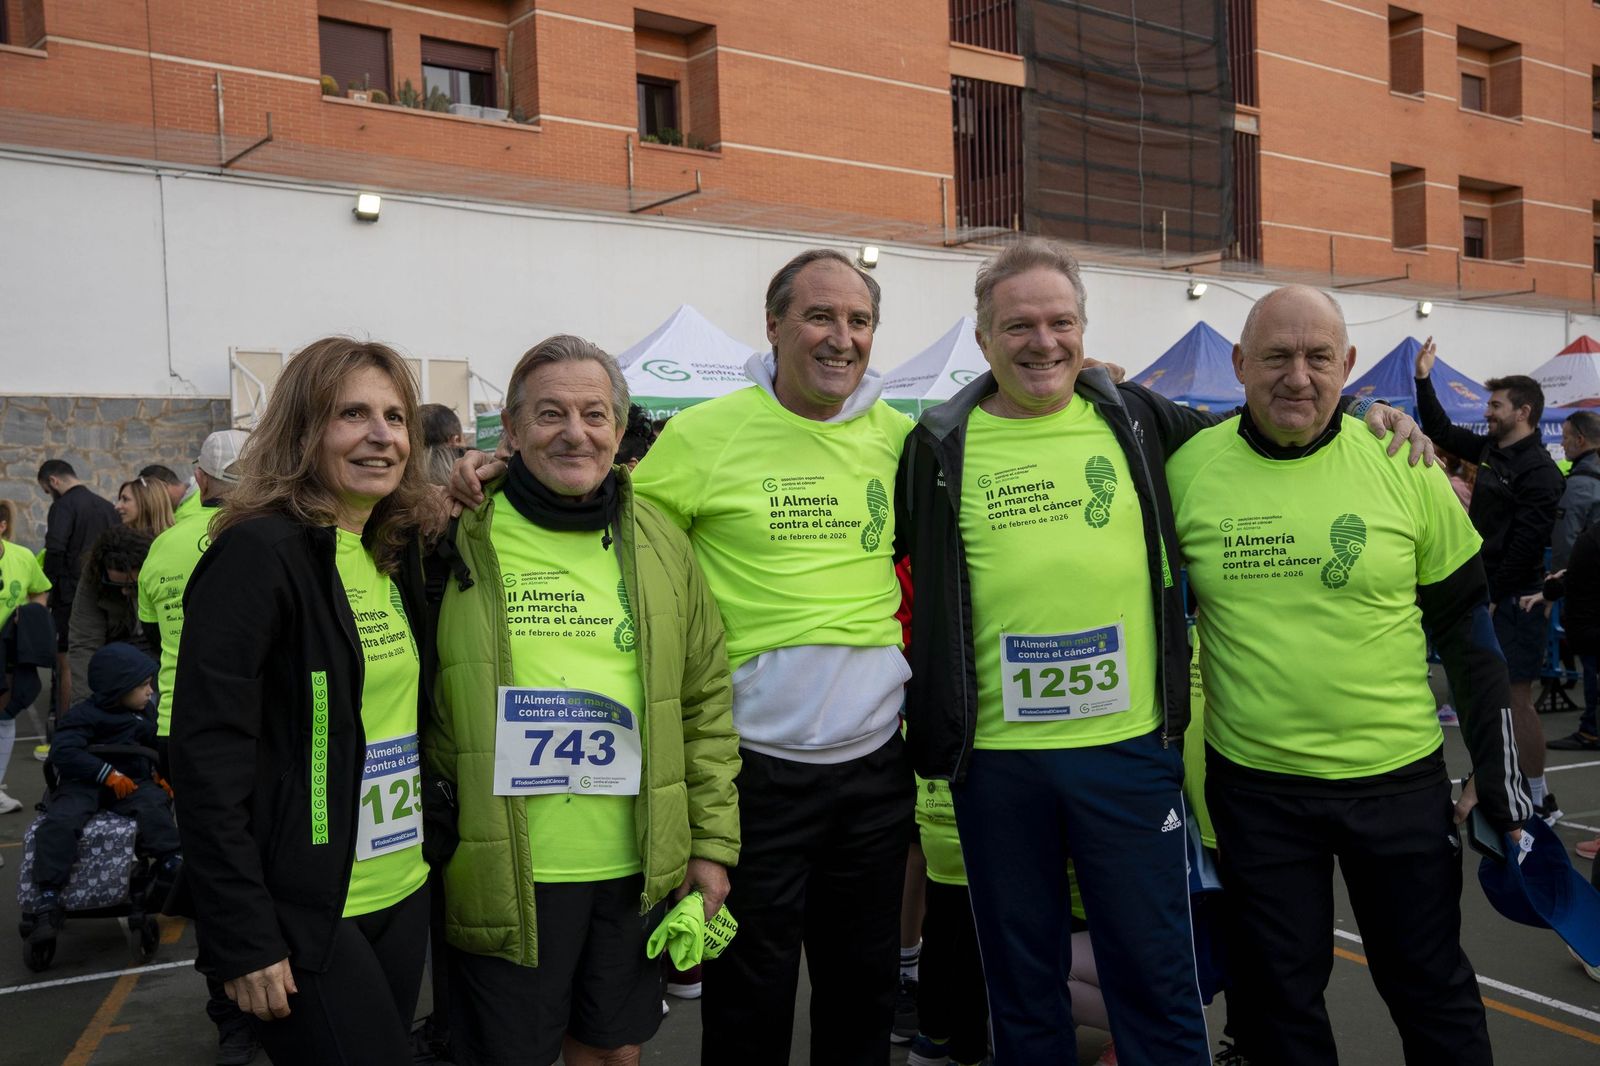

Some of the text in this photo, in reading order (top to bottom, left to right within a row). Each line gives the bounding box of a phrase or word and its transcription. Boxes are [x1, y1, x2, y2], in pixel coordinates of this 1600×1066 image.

[985, 479, 1056, 501] II Almería
[770, 494, 839, 507] II Almería
[987, 492, 1050, 511] en marcha
[770, 507, 833, 518] en marcha
[987, 498, 1083, 521] contra el cáncer
[769, 518, 862, 530] contra el cáncer
[997, 522, 1007, 530] de
[1009, 518, 1037, 529] febrero
[1038, 516, 1048, 524] de
[1049, 513, 1069, 522] 2026
[777, 533, 787, 541] de
[789, 532, 817, 541] febrero
[819, 532, 828, 540] de
[829, 532, 847, 540] 2026
[1223, 533, 1296, 548] II Almería
[1223, 546, 1287, 558] en marcha
[1222, 556, 1322, 569] contra el cáncer
[1240, 572, 1269, 581] febrero
[1283, 570, 1304, 578] 2026
[508, 590, 585, 602] II Almería
[507, 603, 578, 613] en marcha
[507, 614, 614, 625] contra el cáncer
[515, 629, 526, 637] de
[529, 629, 560, 638] febrero
[562, 630, 573, 638] de
[575, 630, 597, 638] 2026
[1018, 639, 1058, 649] Almería
[1075, 632, 1107, 645] marcha
[1018, 646, 1096, 659] contra el cáncer
[1012, 659, 1120, 699] 1253
[522, 694, 566, 706] Almería
[568, 697, 580, 706] en
[518, 708, 609, 719] contra el cáncer
[366, 744, 402, 760] Almería
[524, 729, 616, 767] 743
[364, 760, 397, 774] contra
[398, 756, 406, 767] el
[1161, 819, 1182, 833] adidas
